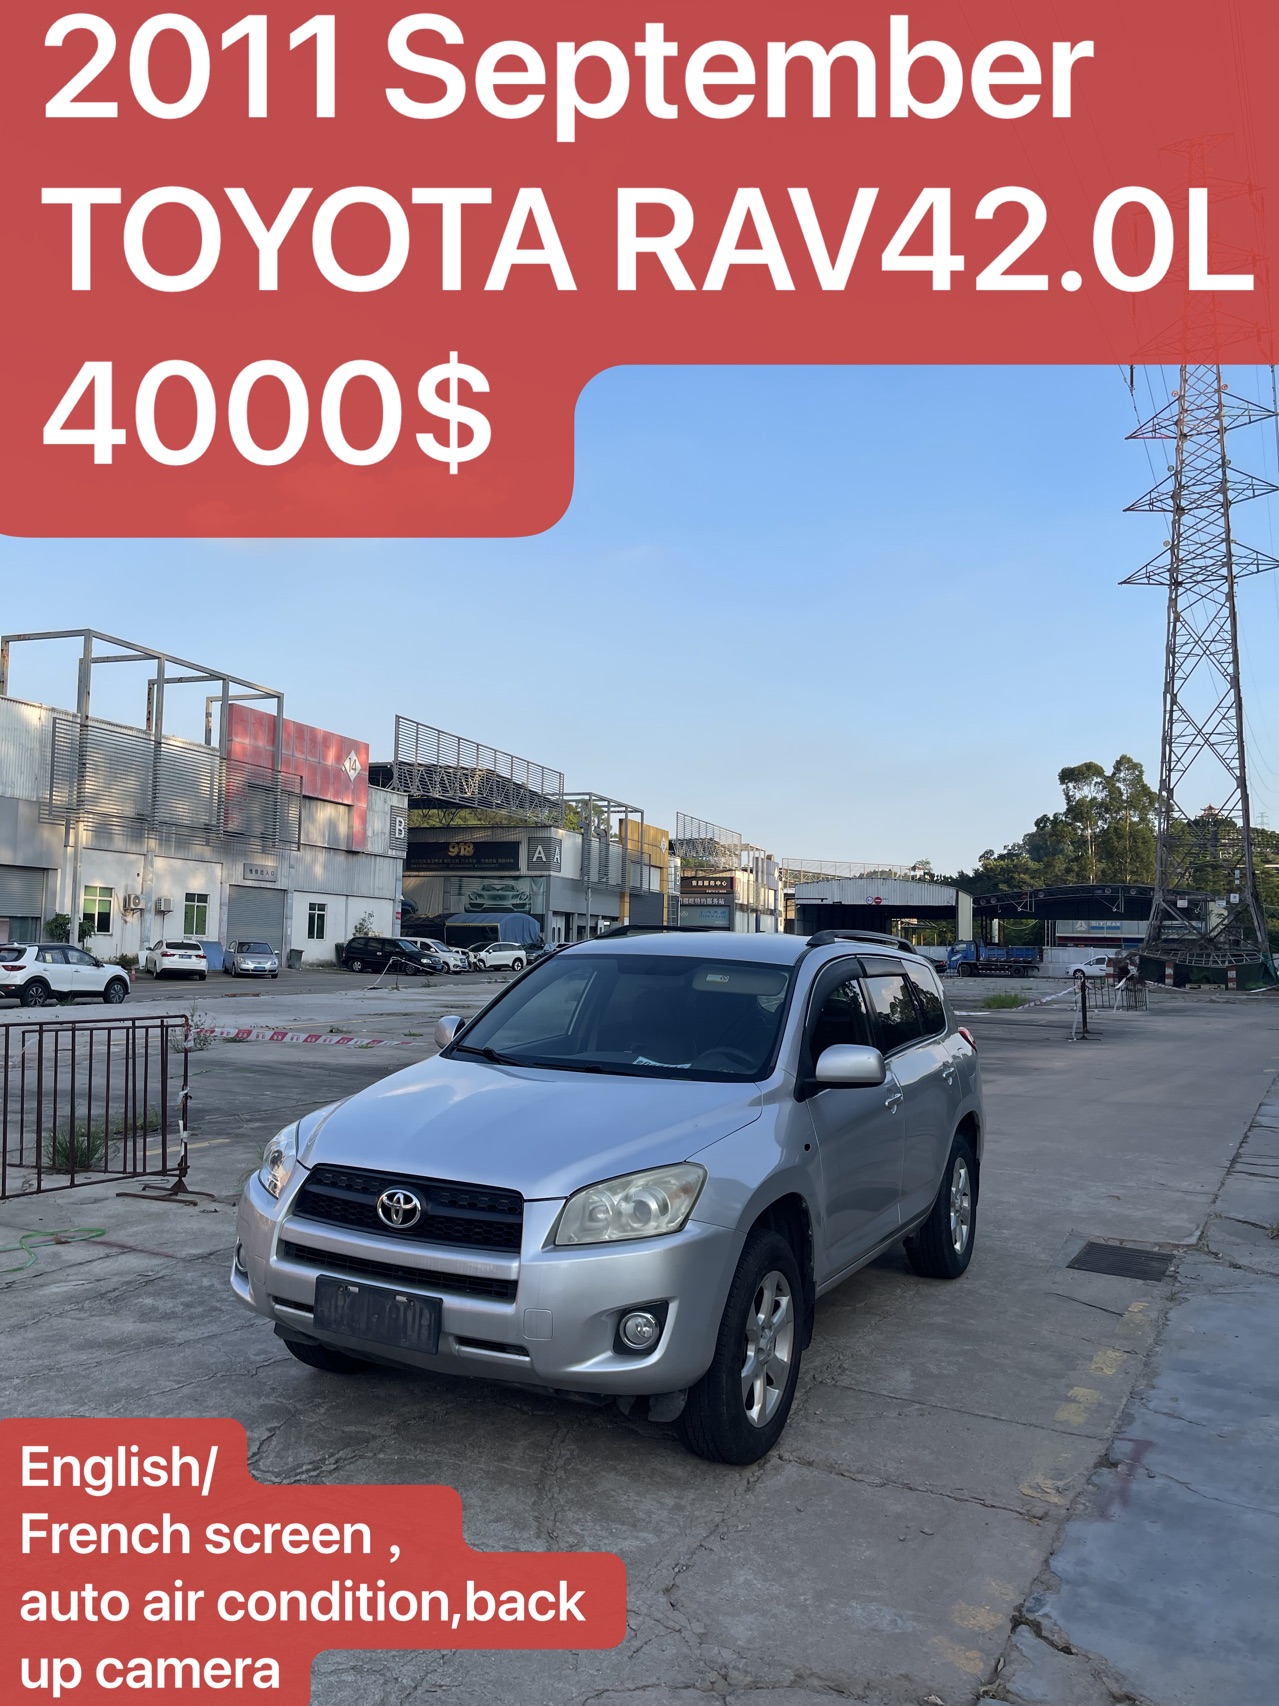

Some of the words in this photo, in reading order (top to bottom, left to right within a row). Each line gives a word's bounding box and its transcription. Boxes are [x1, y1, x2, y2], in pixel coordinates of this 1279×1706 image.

[348, 757, 357, 774] 14
[396, 816, 405, 838] B
[447, 842, 475, 856] 918
[532, 845, 547, 862] A
[553, 846, 561, 864] A
